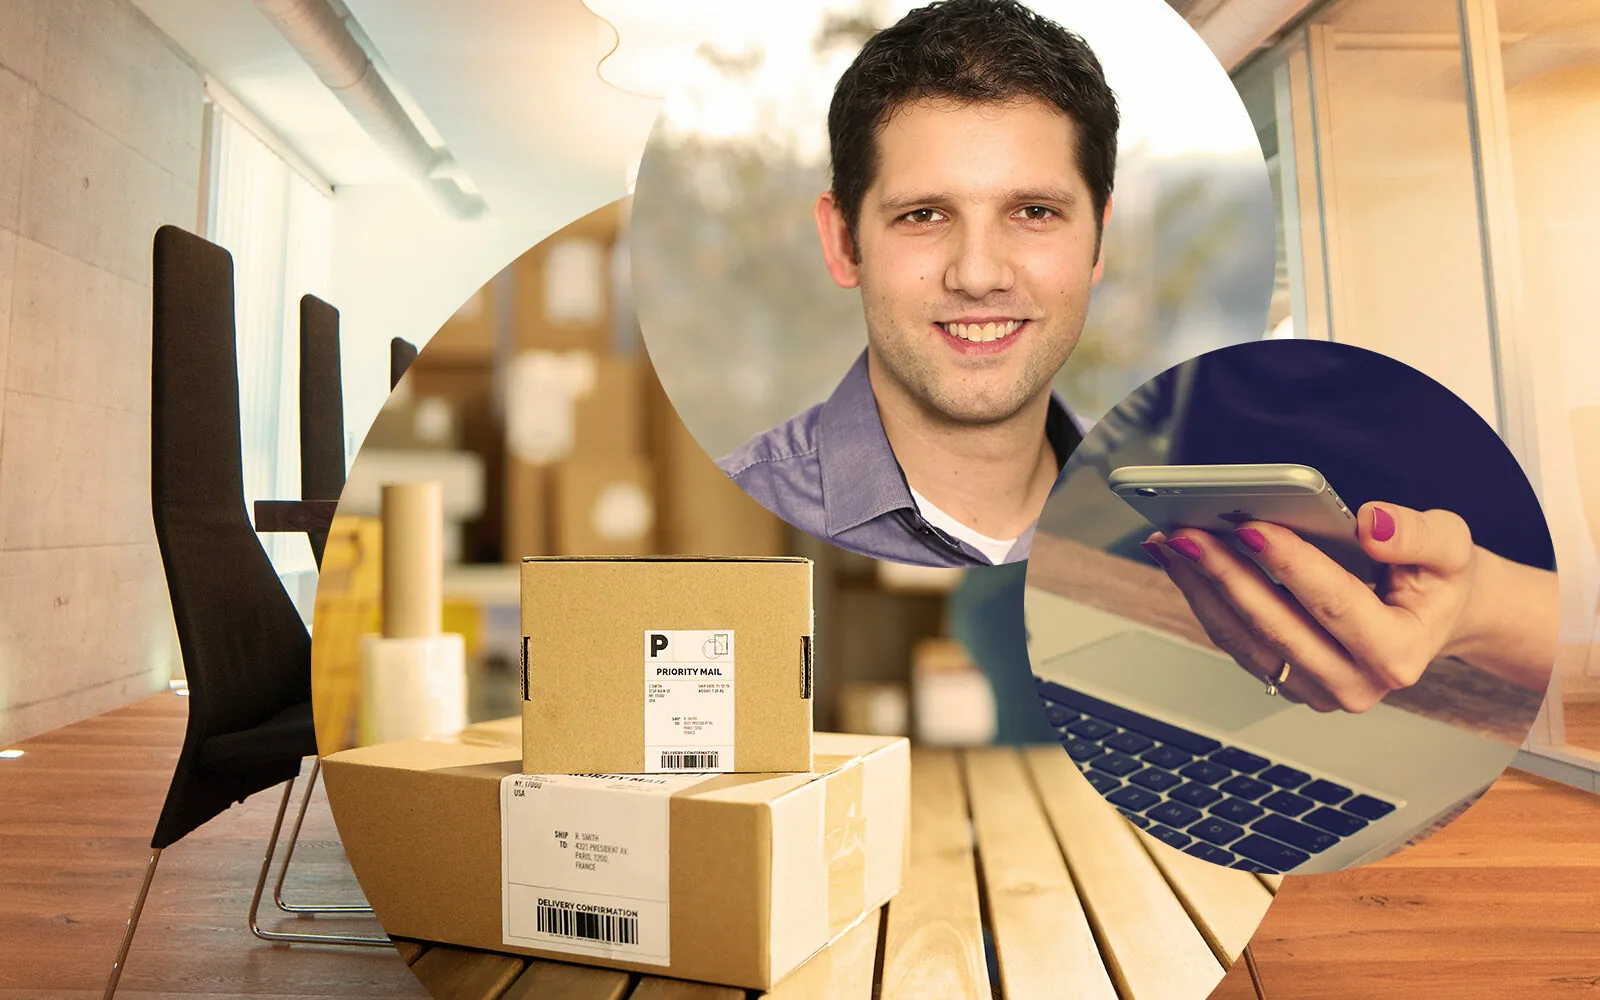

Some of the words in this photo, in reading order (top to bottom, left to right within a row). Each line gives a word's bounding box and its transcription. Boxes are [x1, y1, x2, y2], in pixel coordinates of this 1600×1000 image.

[650, 634, 669, 658] P
[656, 668, 699, 676] PRIORITY
[700, 668, 723, 676] MAIL
[514, 788, 526, 797] USA
[554, 830, 568, 839] SHIP
[582, 833, 599, 842] SMITH
[574, 842, 588, 851] 4321
[589, 844, 618, 854] PRESIDENT
[574, 861, 596, 871] FRANCE
[537, 898, 575, 910] DELIVERY
[576, 904, 638, 918] CONFIRMATION
